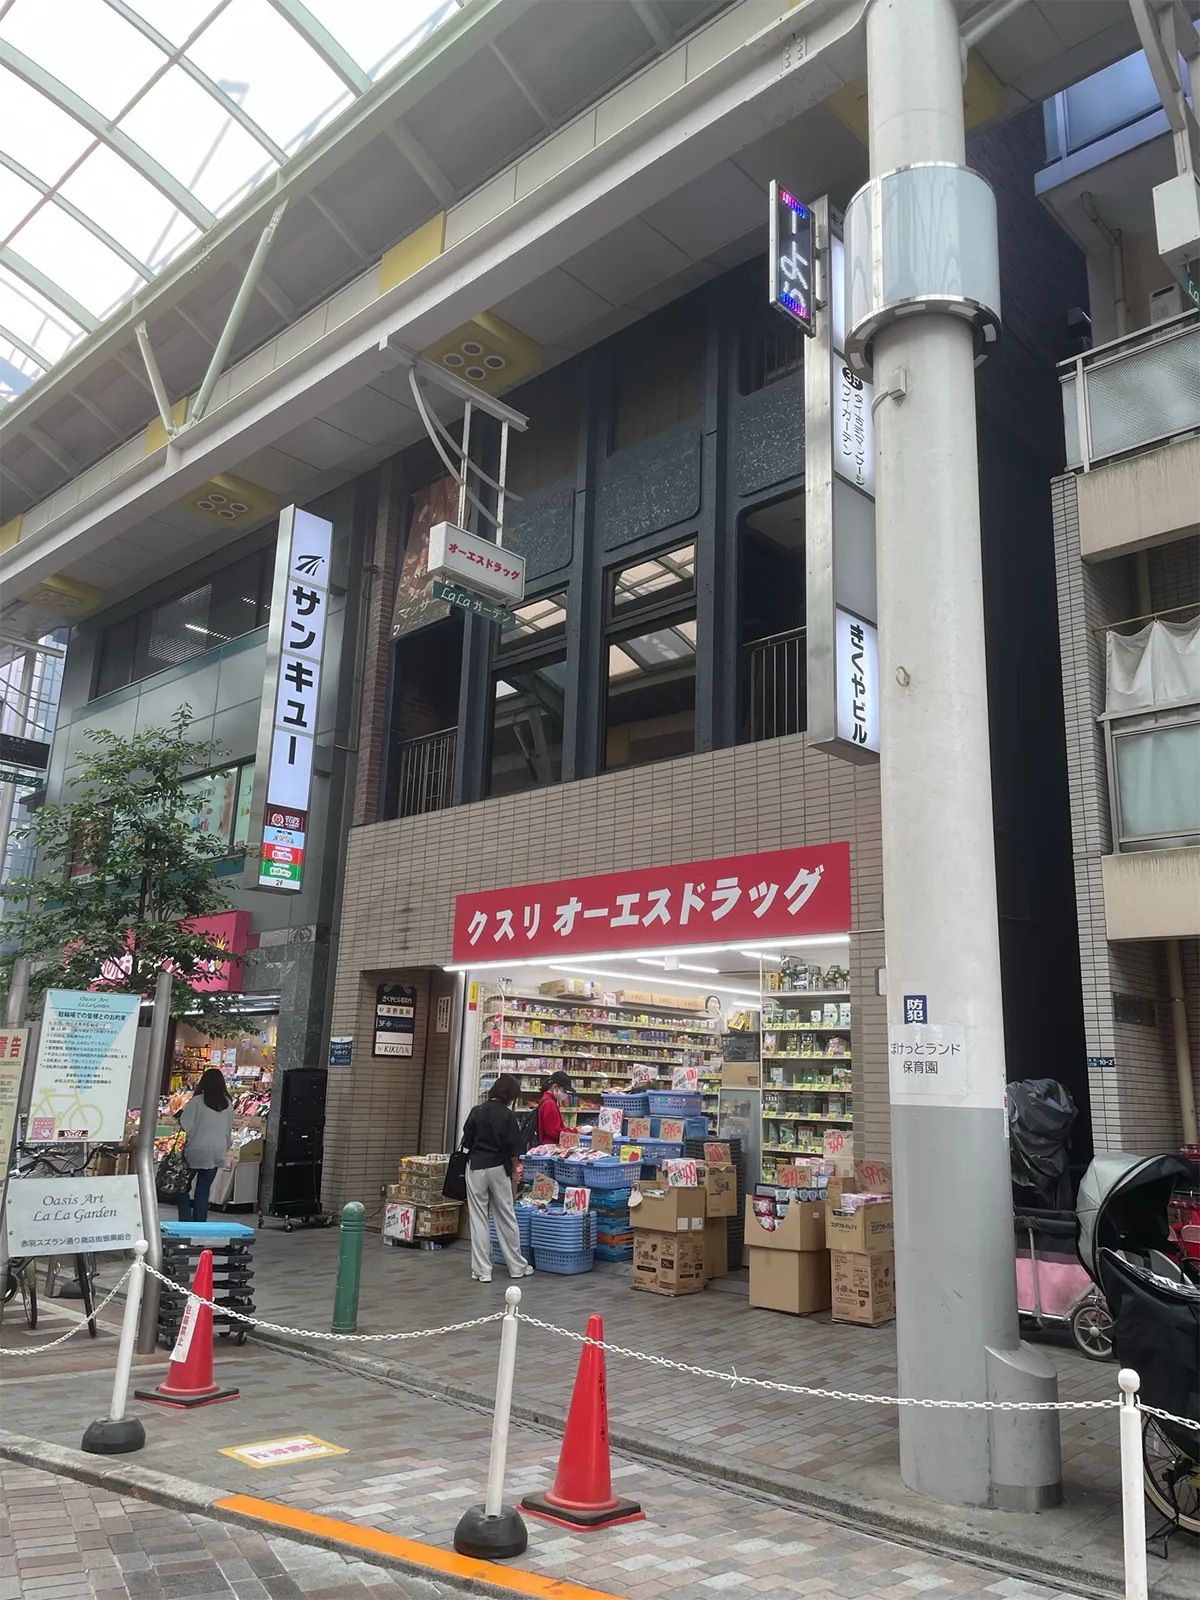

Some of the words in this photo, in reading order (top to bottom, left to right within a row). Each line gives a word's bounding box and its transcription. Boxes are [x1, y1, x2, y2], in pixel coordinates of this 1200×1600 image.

[448, 543, 520, 580] オーエスドラッグ
[473, 601, 511, 622] ガーデン
[283, 585, 321, 765] サンキュー
[850, 623, 868, 744] きくやビル
[467, 903, 541, 947] クスリ
[552, 864, 825, 937] オーエスドラッグ
[384, 1045, 410, 1054] KIKUYA
[903, 1060, 938, 1074] 保育園
[43, 1194, 79, 1205] Oasis
[81, 1193, 104, 1205] Art
[33, 1210, 50, 1222] La
[53, 1209, 70, 1221] La
[74, 1206, 117, 1223] Garden
[21, 1232, 131, 1248] 赤羽スズラン通り商店街振興組合
